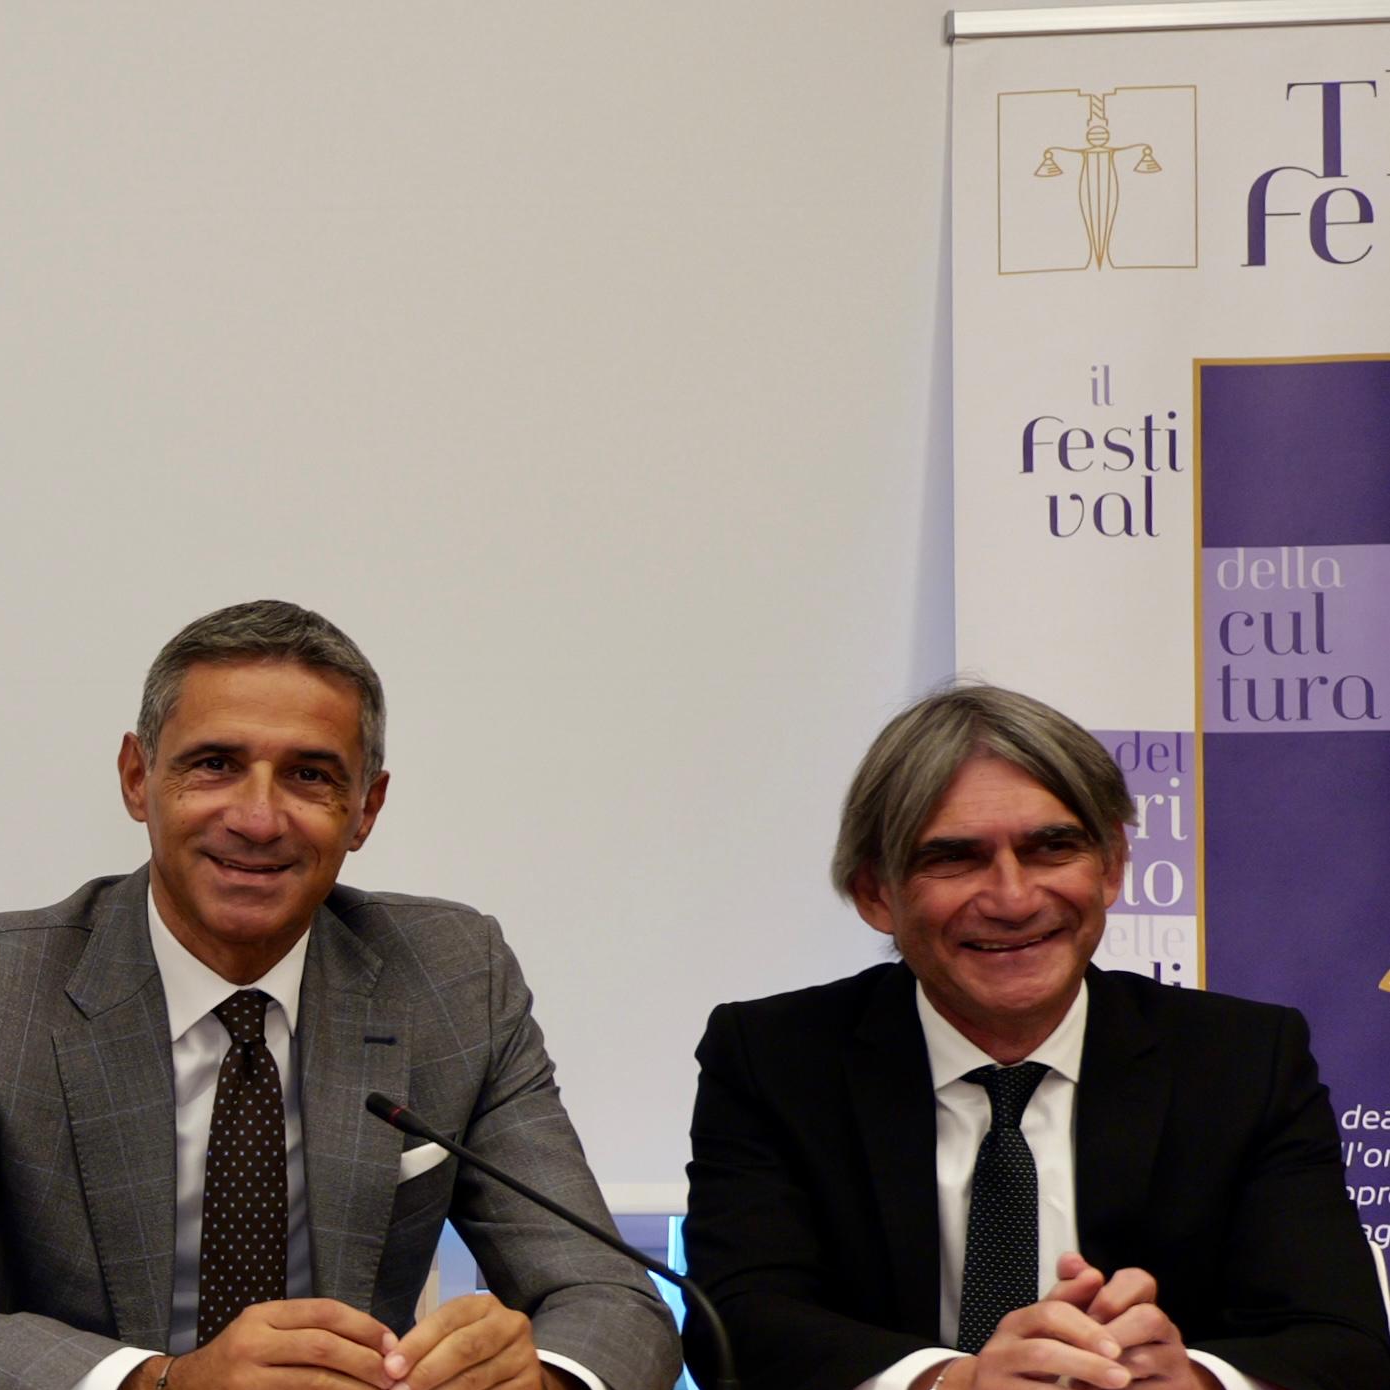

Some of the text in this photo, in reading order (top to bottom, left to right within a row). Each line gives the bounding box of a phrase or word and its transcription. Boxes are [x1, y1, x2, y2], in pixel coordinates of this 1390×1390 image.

[1090, 365, 1114, 408] il
[1019, 411, 1184, 475] festi
[1046, 475, 1161, 539] val
[1216, 548, 1346, 591] della
[1220, 592, 1332, 657] cul
[1216, 664, 1382, 724] tura
[1115, 731, 1187, 774] del
